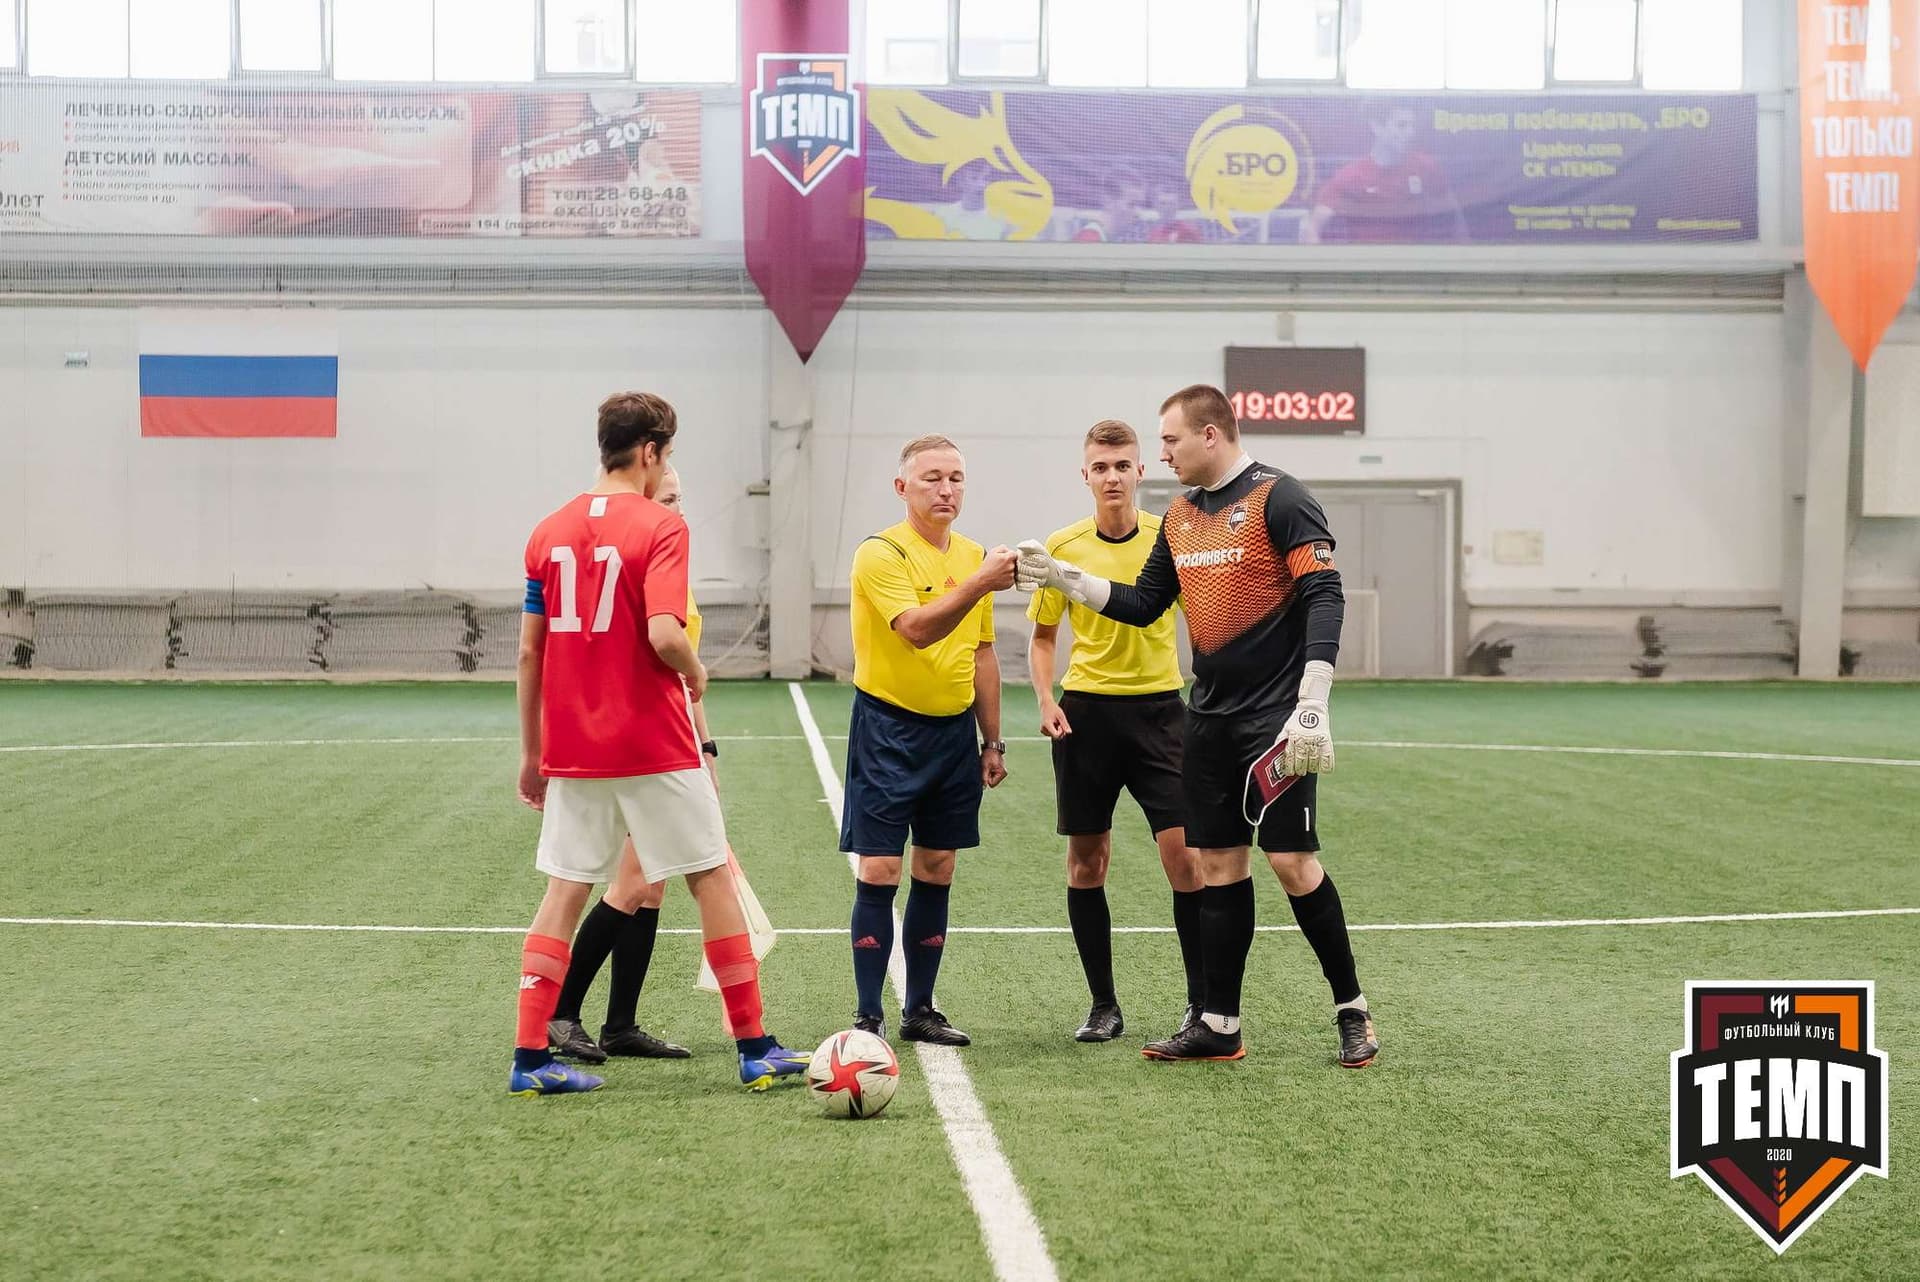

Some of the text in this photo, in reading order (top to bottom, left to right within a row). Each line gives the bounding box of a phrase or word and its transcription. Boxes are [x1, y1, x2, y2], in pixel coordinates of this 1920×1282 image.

[606, 114, 667, 149] 20%
[761, 92, 850, 142] ТЕМП
[1811, 115, 1913, 158] ТОЛЬКО
[64, 148, 157, 167] ДЕТСКИЙ
[1216, 152, 1287, 177] .БРО
[1824, 171, 1900, 213] ТЕМП!
[1233, 391, 1356, 421] 19:03:02
[550, 545, 624, 633] 17
[1303, 806, 1310, 832] 1
